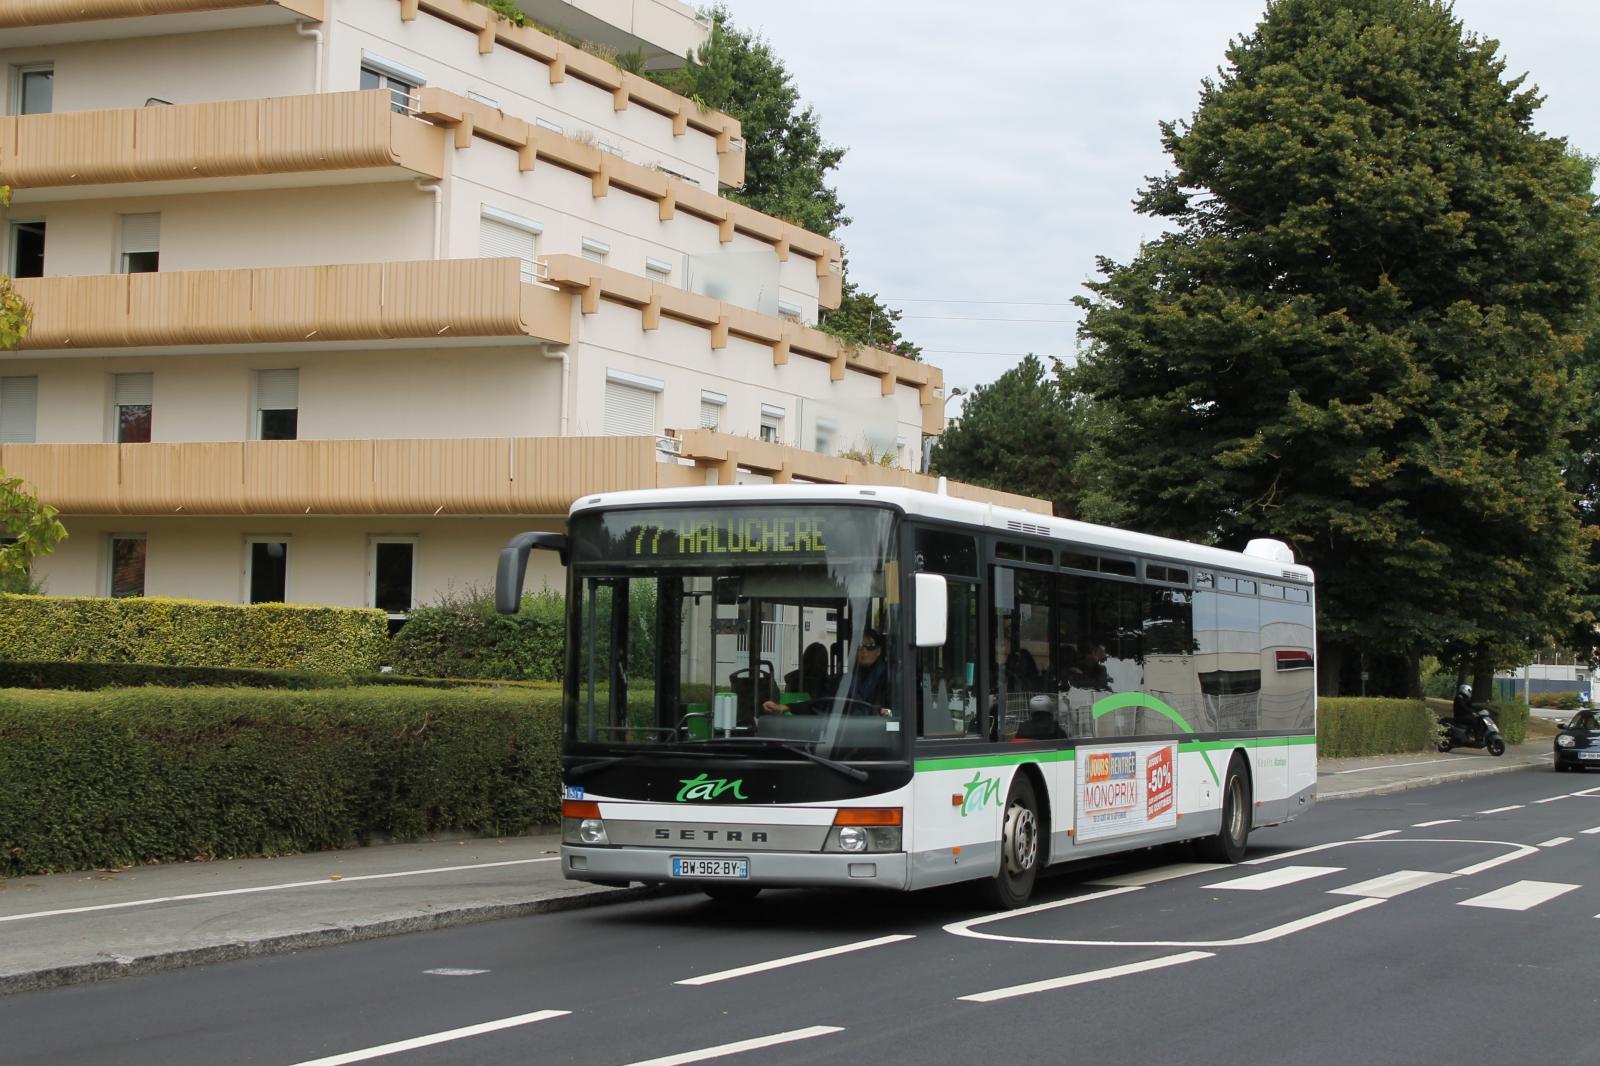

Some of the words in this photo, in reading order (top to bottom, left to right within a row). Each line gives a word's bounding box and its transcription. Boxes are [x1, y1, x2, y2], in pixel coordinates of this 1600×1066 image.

[632, 520, 664, 554] 77
[679, 517, 826, 553] HALUCHERE
[676, 773, 749, 802] tan
[1148, 762, 1171, 792] -50%
[961, 771, 1004, 817] tan
[1086, 782, 1135, 808] MONOPRIX
[655, 829, 767, 842] SETRA
